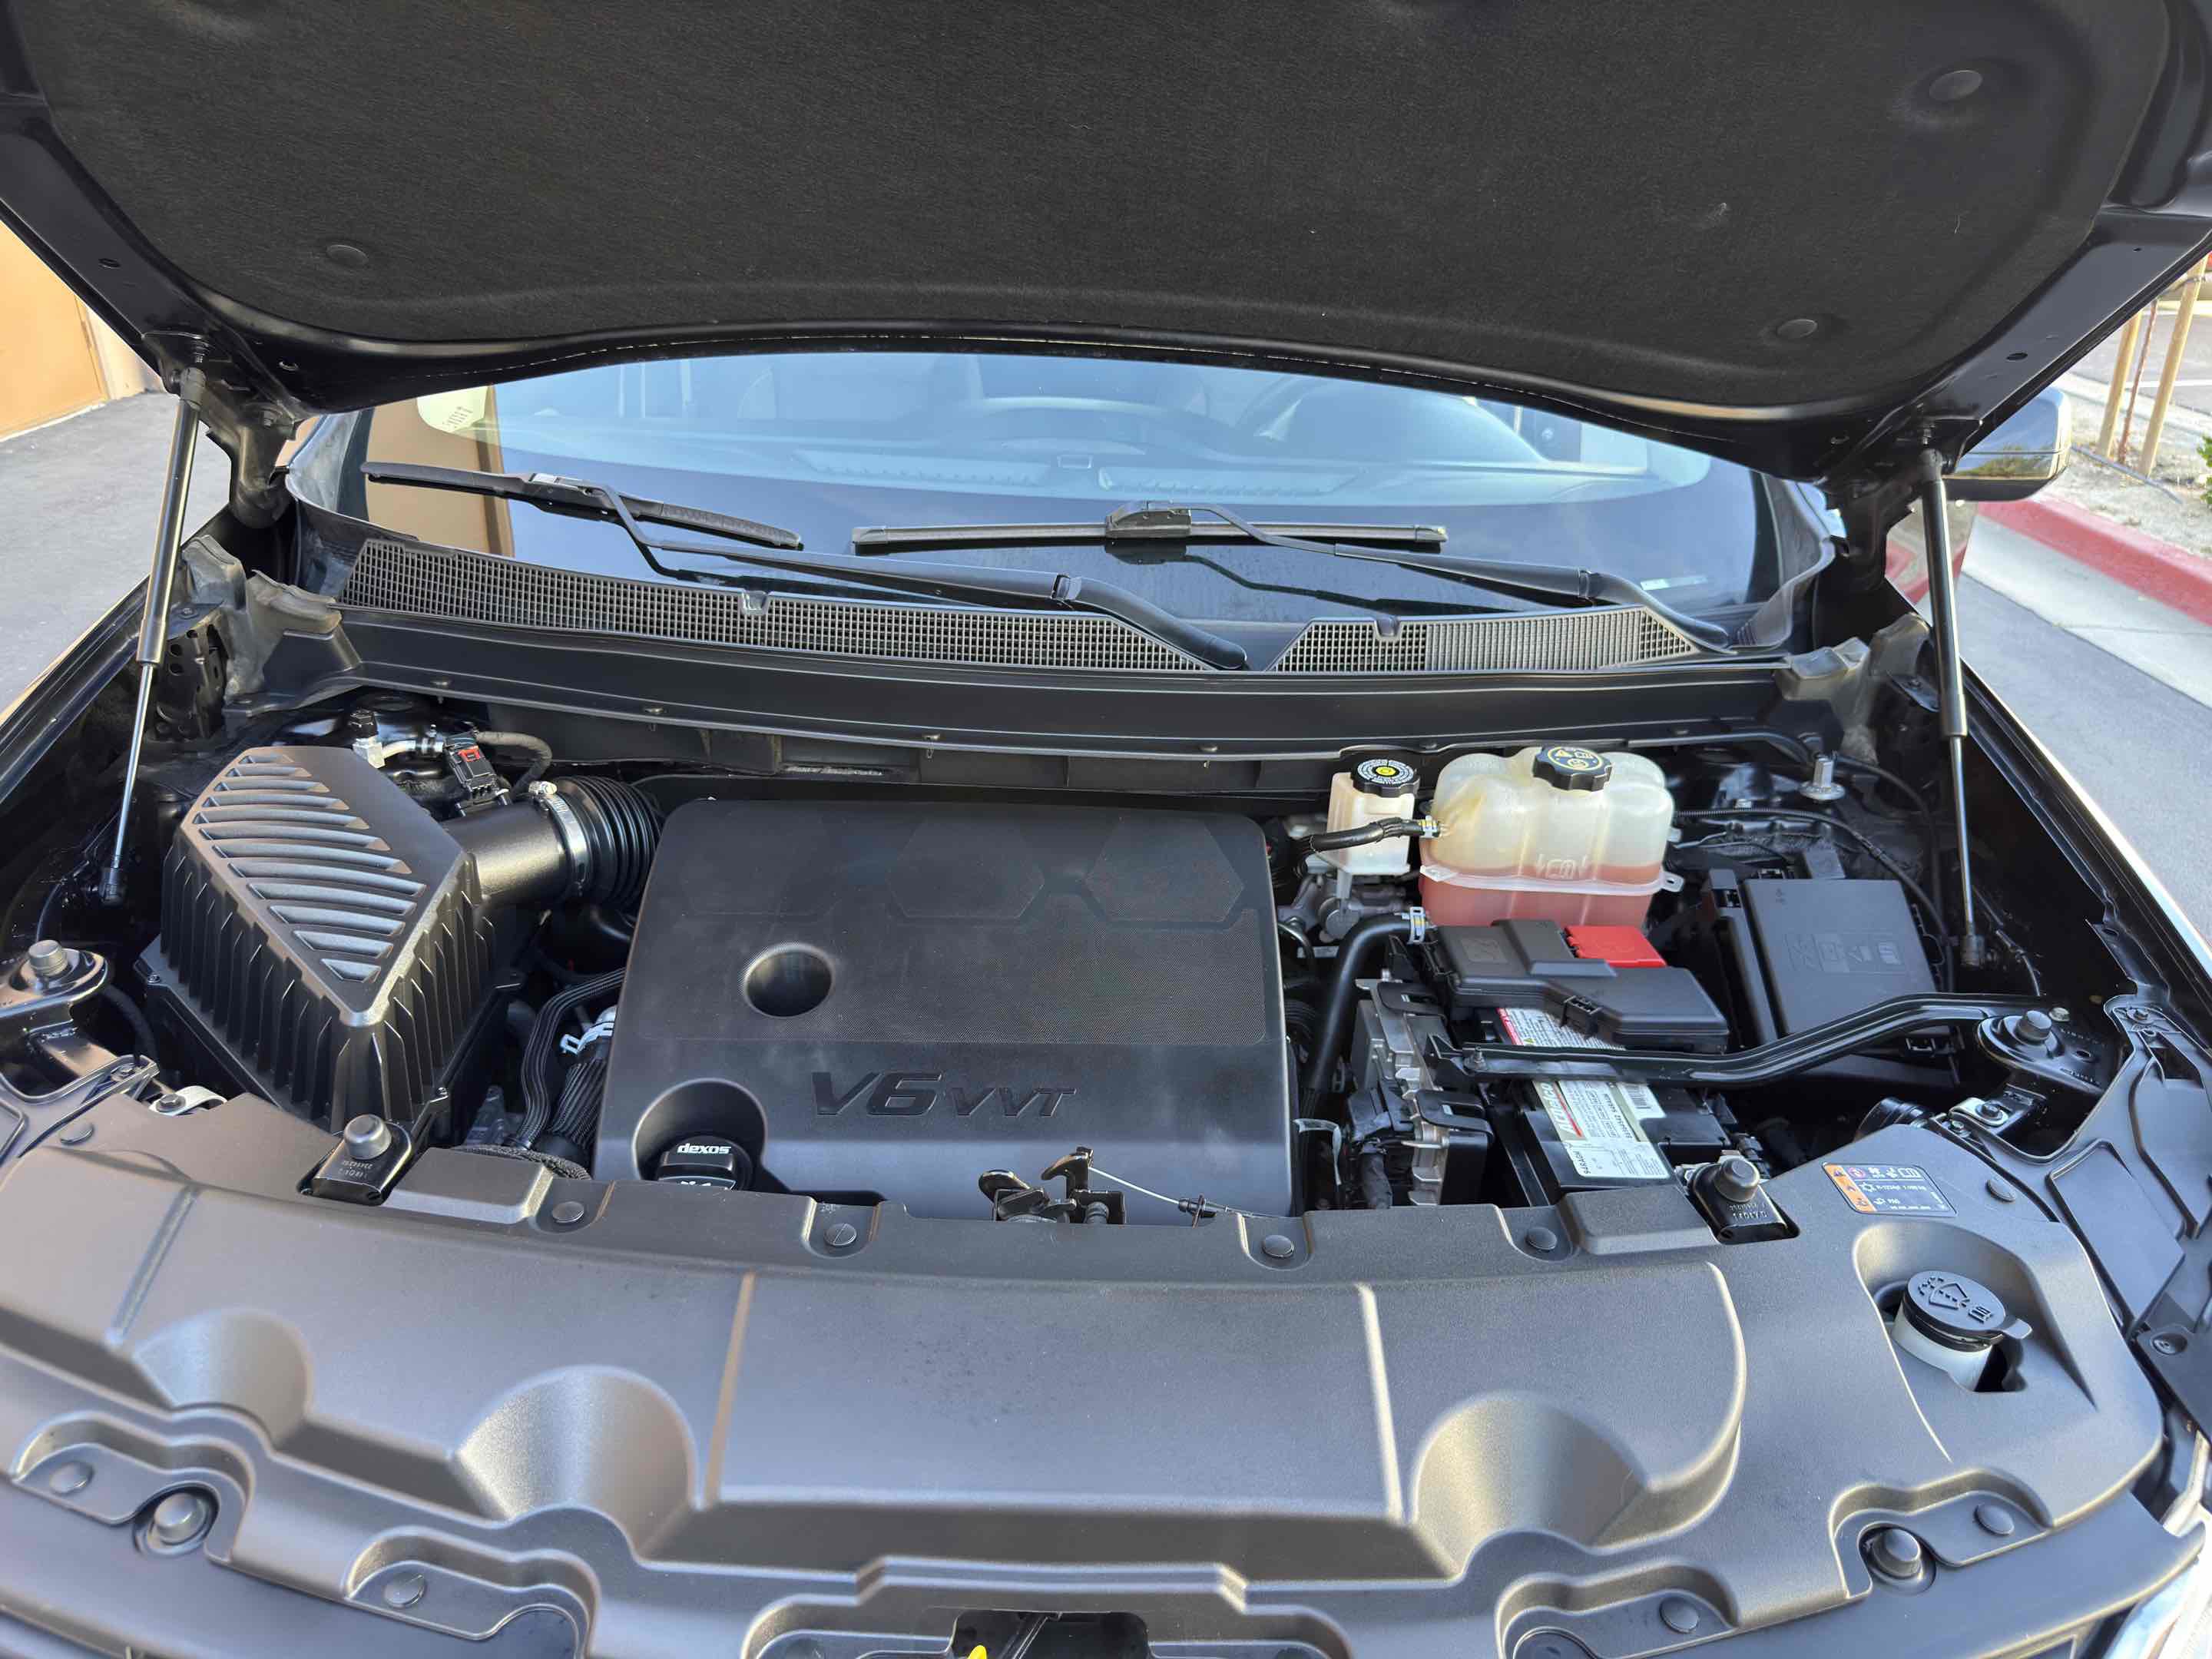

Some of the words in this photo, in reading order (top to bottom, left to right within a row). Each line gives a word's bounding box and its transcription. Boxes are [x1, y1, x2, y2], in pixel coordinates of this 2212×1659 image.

[812, 1071, 942, 1117] V6
[950, 1087, 1076, 1118] VVT
[677, 1143, 732, 1154] dexos
